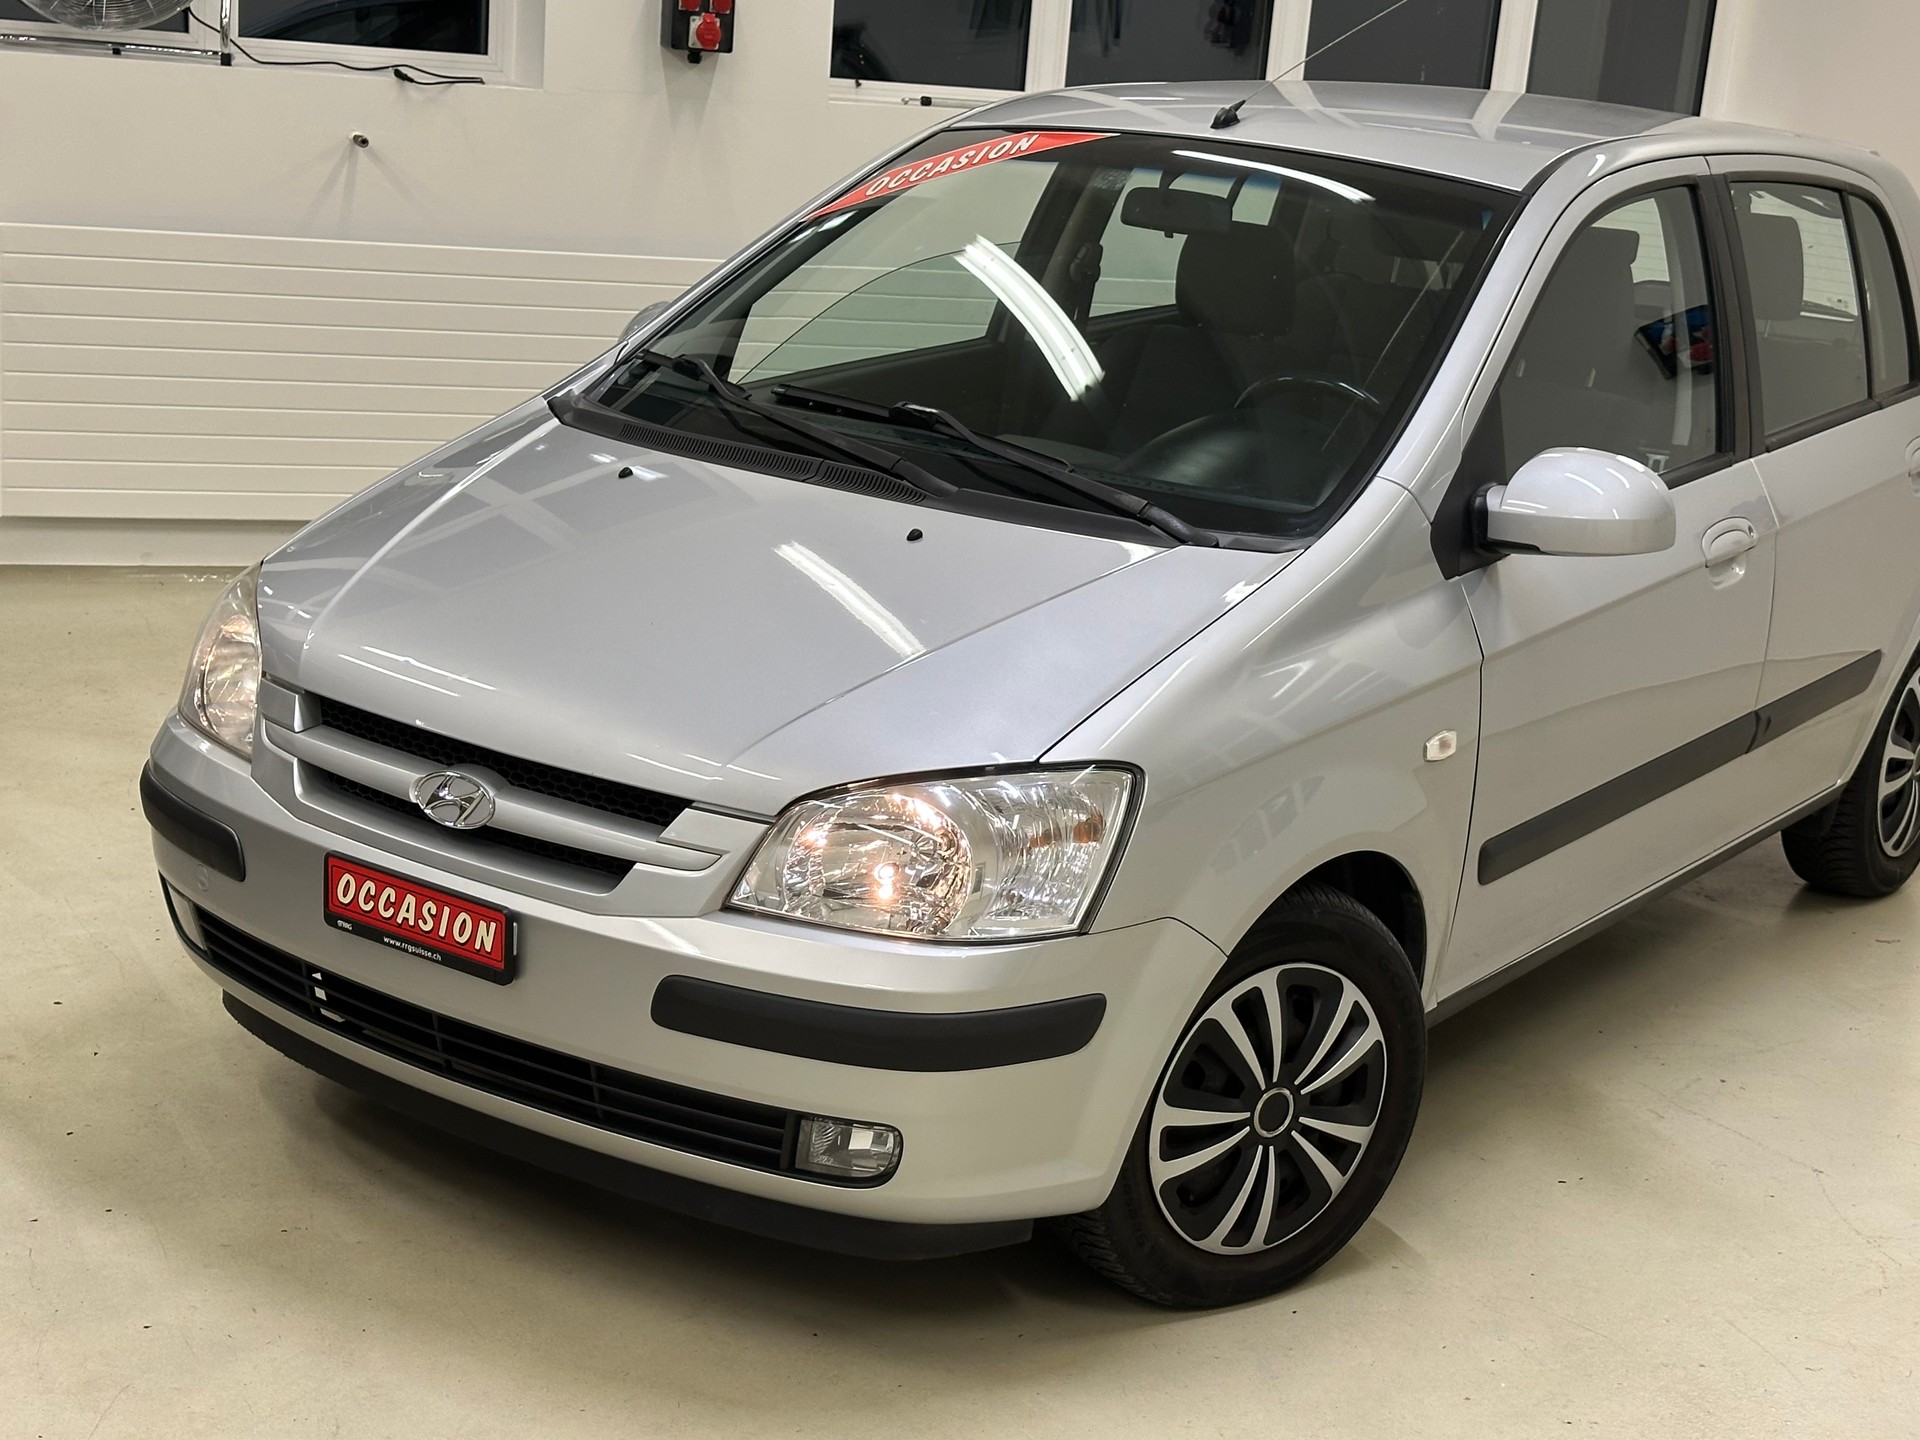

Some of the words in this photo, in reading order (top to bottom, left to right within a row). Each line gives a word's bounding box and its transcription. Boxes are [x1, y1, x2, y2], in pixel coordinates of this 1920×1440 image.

[865, 134, 1040, 196] OCCASION
[337, 873, 496, 952] OCCASION
[383, 936, 442, 961] www.rrgsuisse.ch
